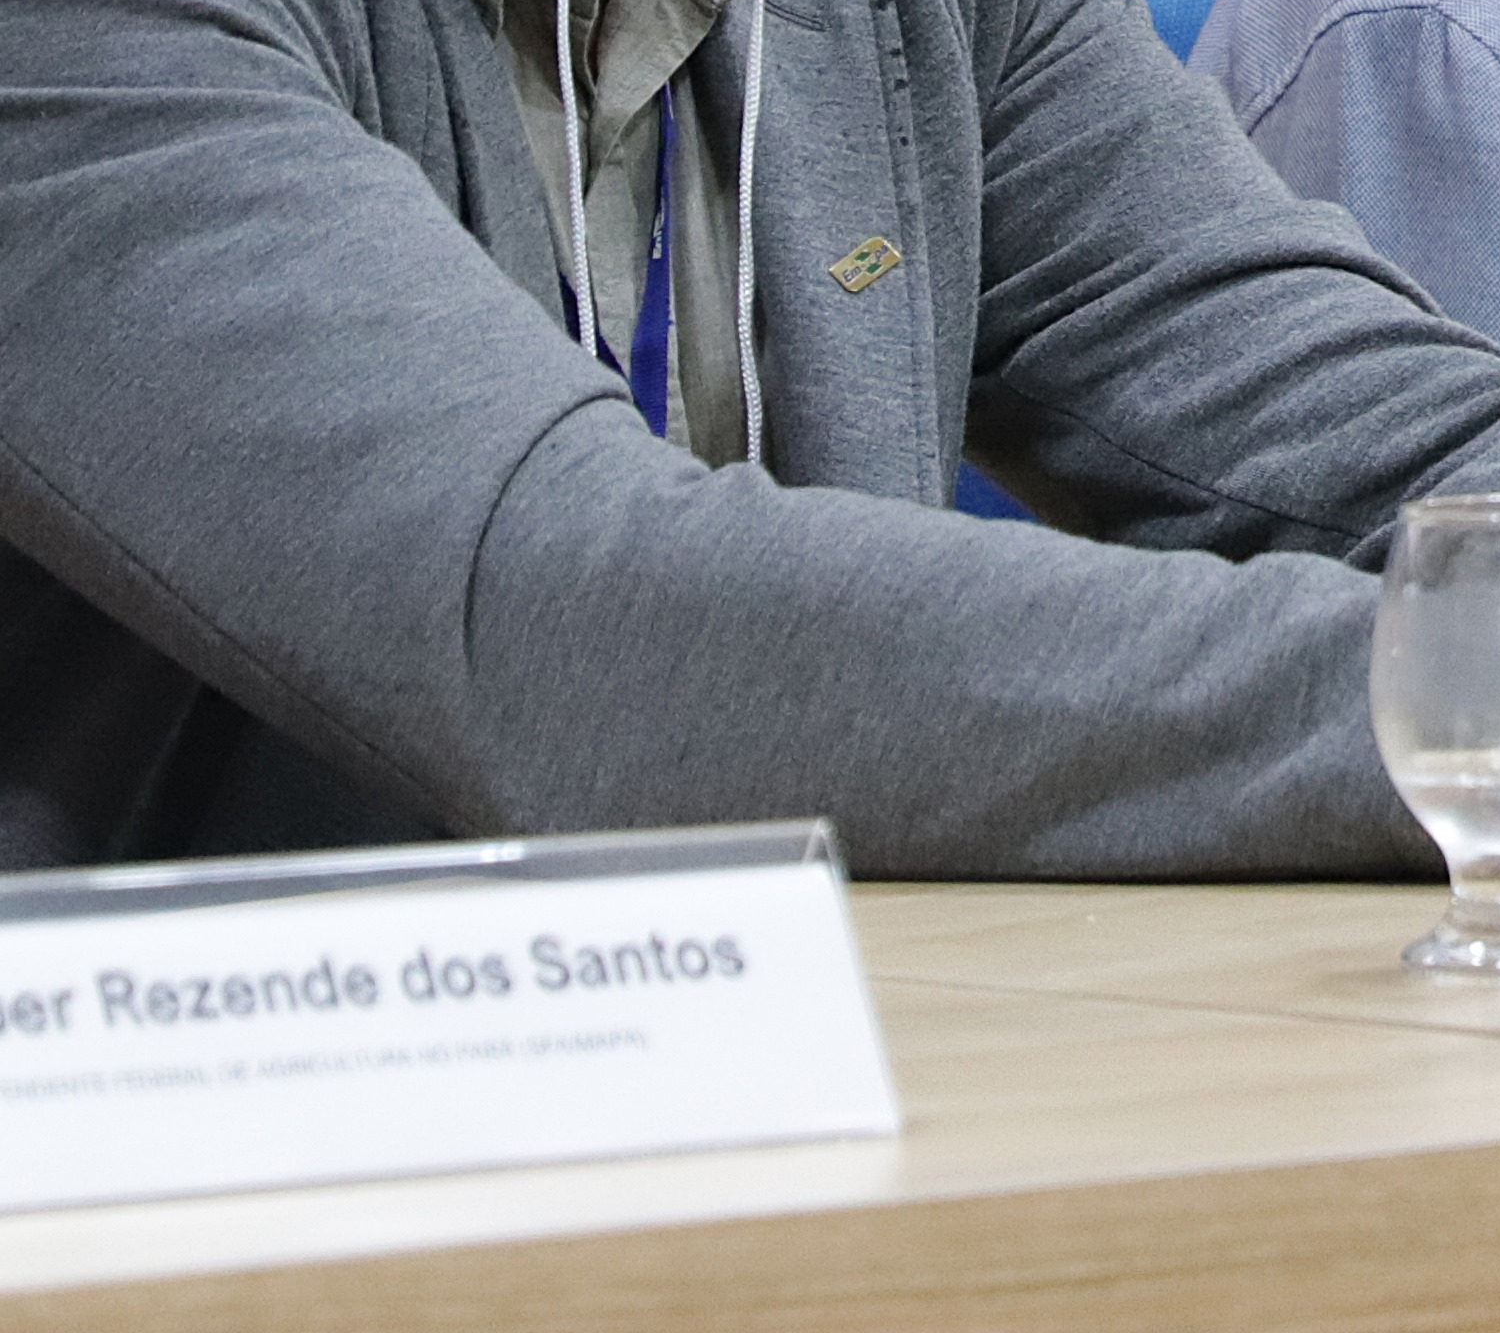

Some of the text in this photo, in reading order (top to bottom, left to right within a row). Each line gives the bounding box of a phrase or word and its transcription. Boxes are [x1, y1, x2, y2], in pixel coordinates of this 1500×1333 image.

[0, 932, 745, 1036] er Rezende dos Santos
